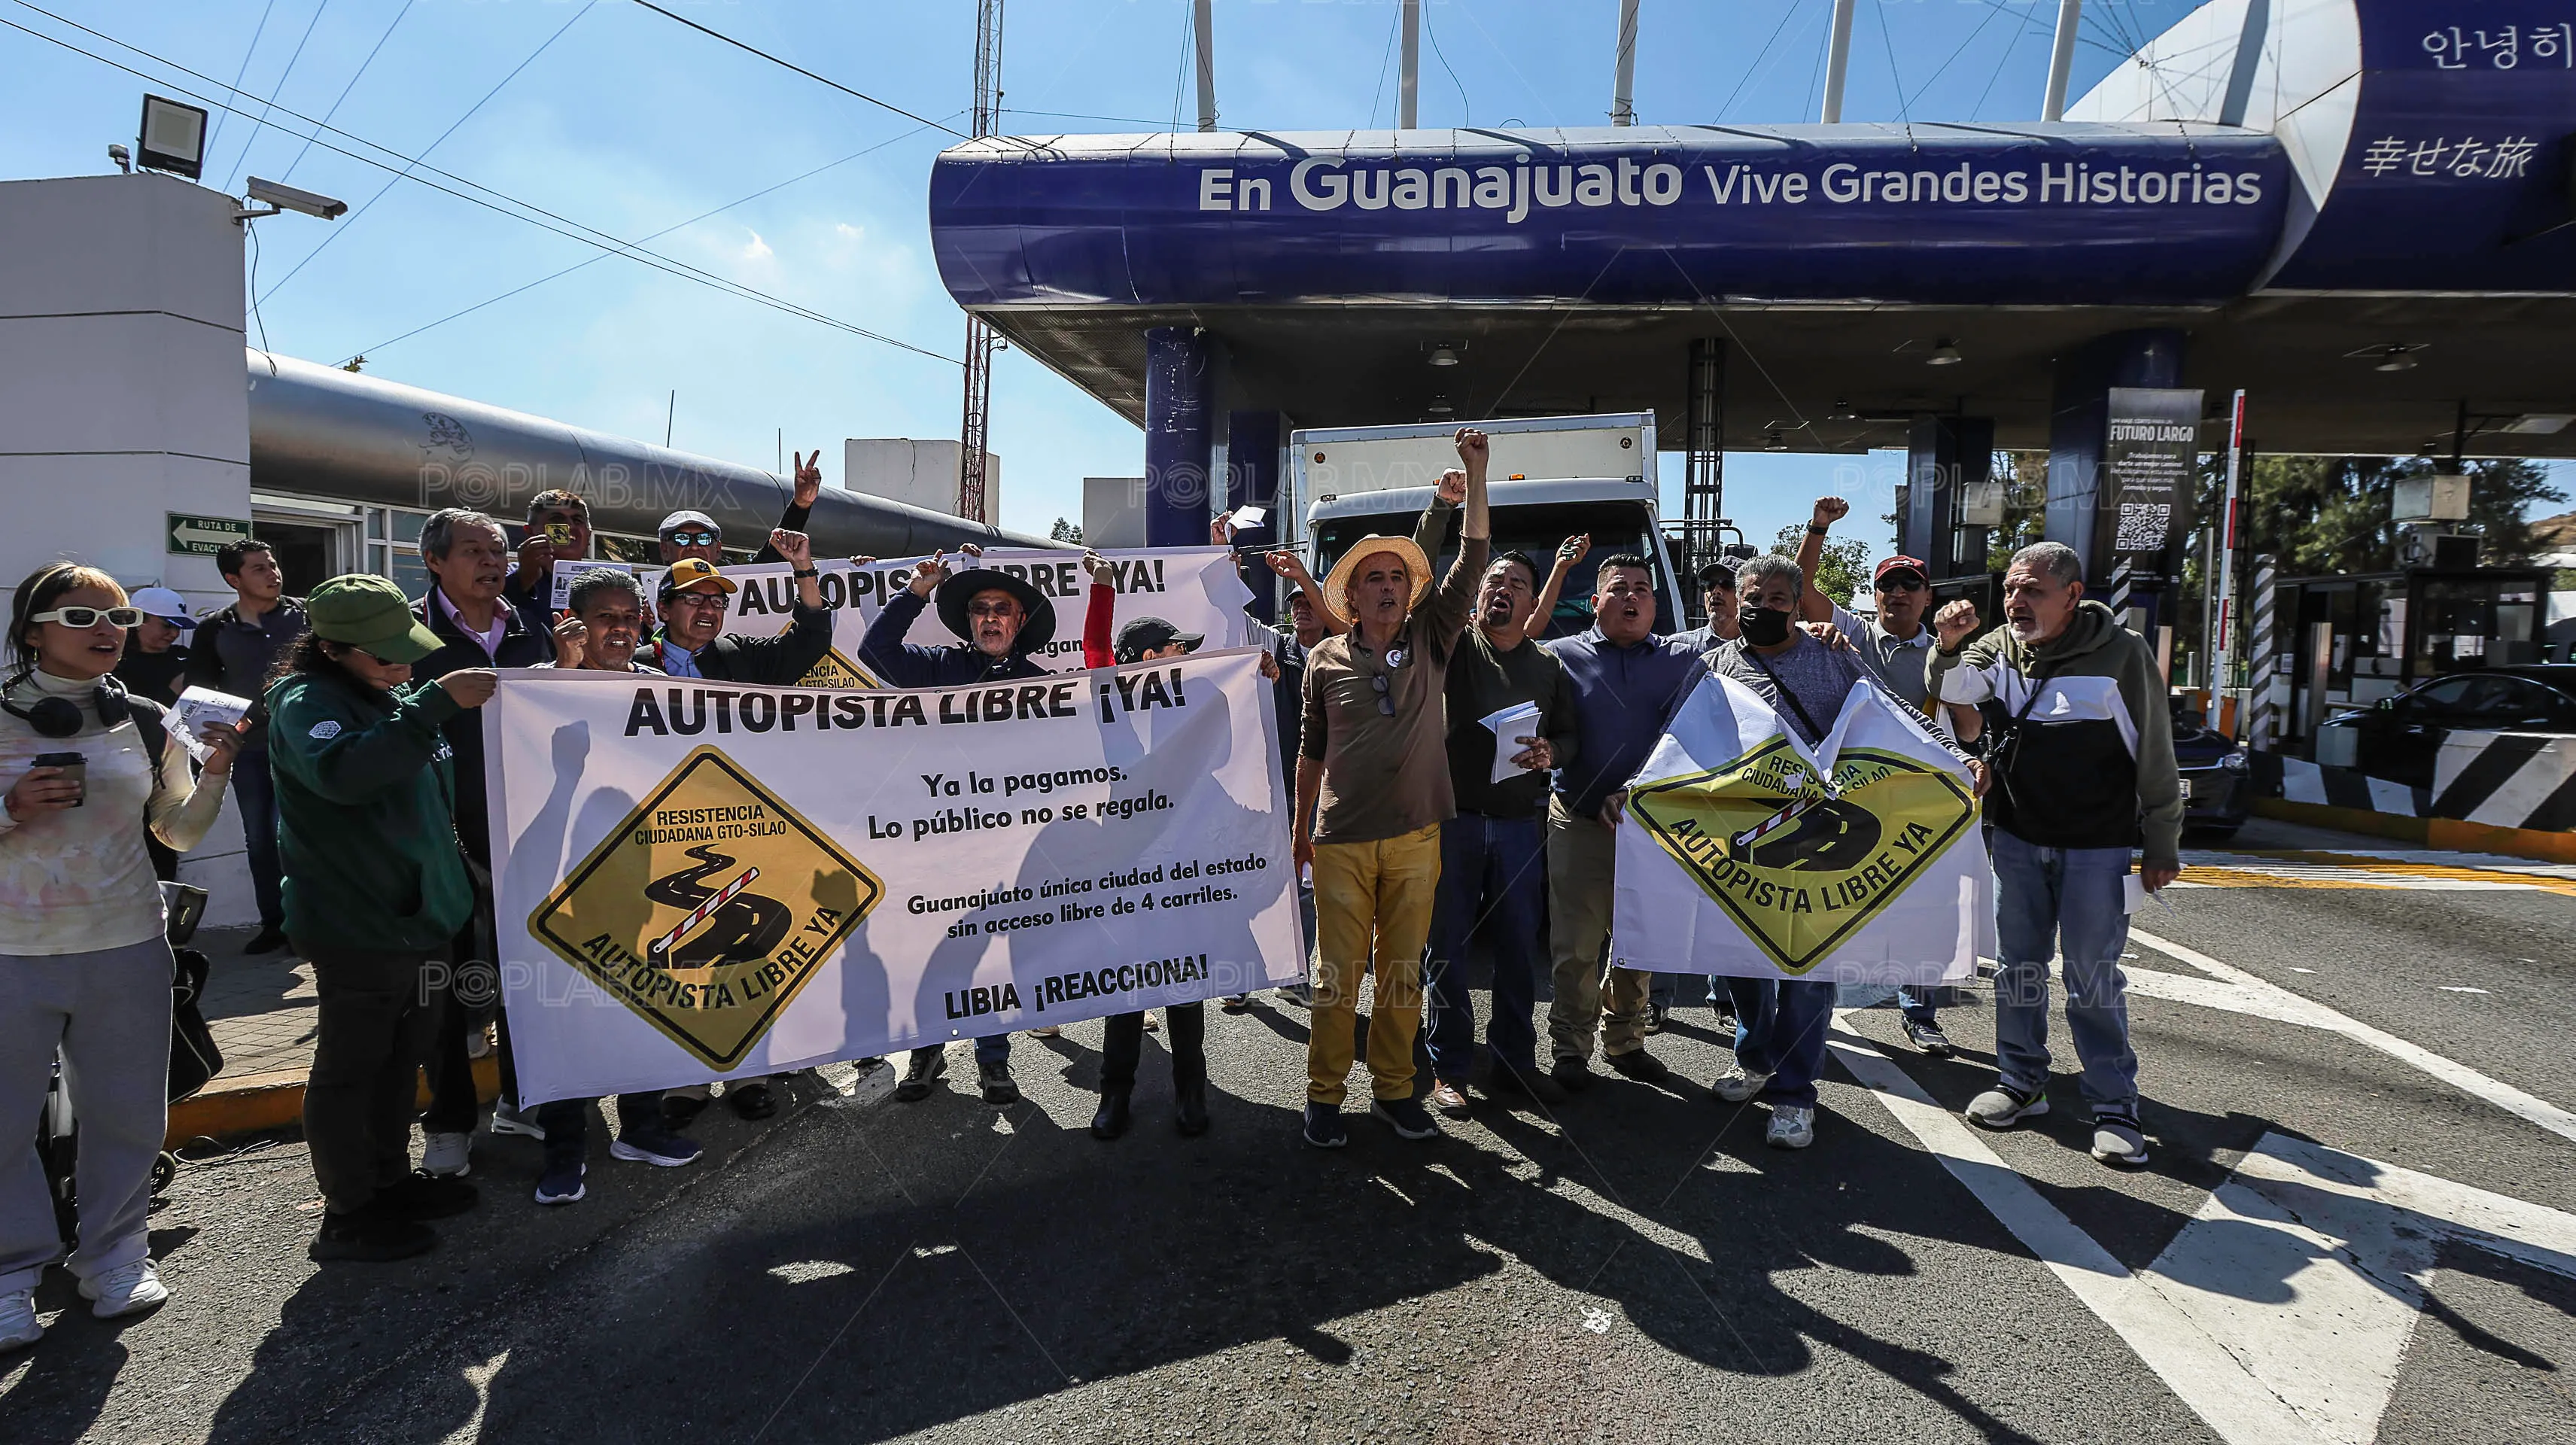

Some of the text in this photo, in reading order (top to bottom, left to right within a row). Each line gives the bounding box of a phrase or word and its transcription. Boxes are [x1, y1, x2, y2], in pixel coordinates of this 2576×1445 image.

[2362, 136, 2539, 178] 幸せな旅
[1200, 154, 2262, 224] En Guanajuato Vive Grandes Historias
[2109, 425, 2194, 442] FUTURO LARGO
[192, 543, 221, 553] EVACU
[197, 520, 236, 531] RUTA DE
[1112, 559, 1166, 594] YA!
[624, 668, 1187, 737] AUTOPISTA LIBRE ¡YA!
[921, 765, 1128, 798] Ya la pagamos.
[634, 820, 787, 846] CIUDADANA GTO-SILAO
[656, 805, 765, 826] RESISTENCIA
[868, 789, 1175, 841] Lo público no se regala.
[908, 853, 1267, 915] Guanajuato única ciudad del estado
[1668, 817, 1933, 913] AUTOPISTA LIBRE YA
[947, 885, 1238, 938] sin acceso libre de 4 carriles.
[582, 905, 842, 1010] AUTOPISTA LIBRE YA
[944, 954, 1209, 1020] LIBIA ¡REACCIONA!
